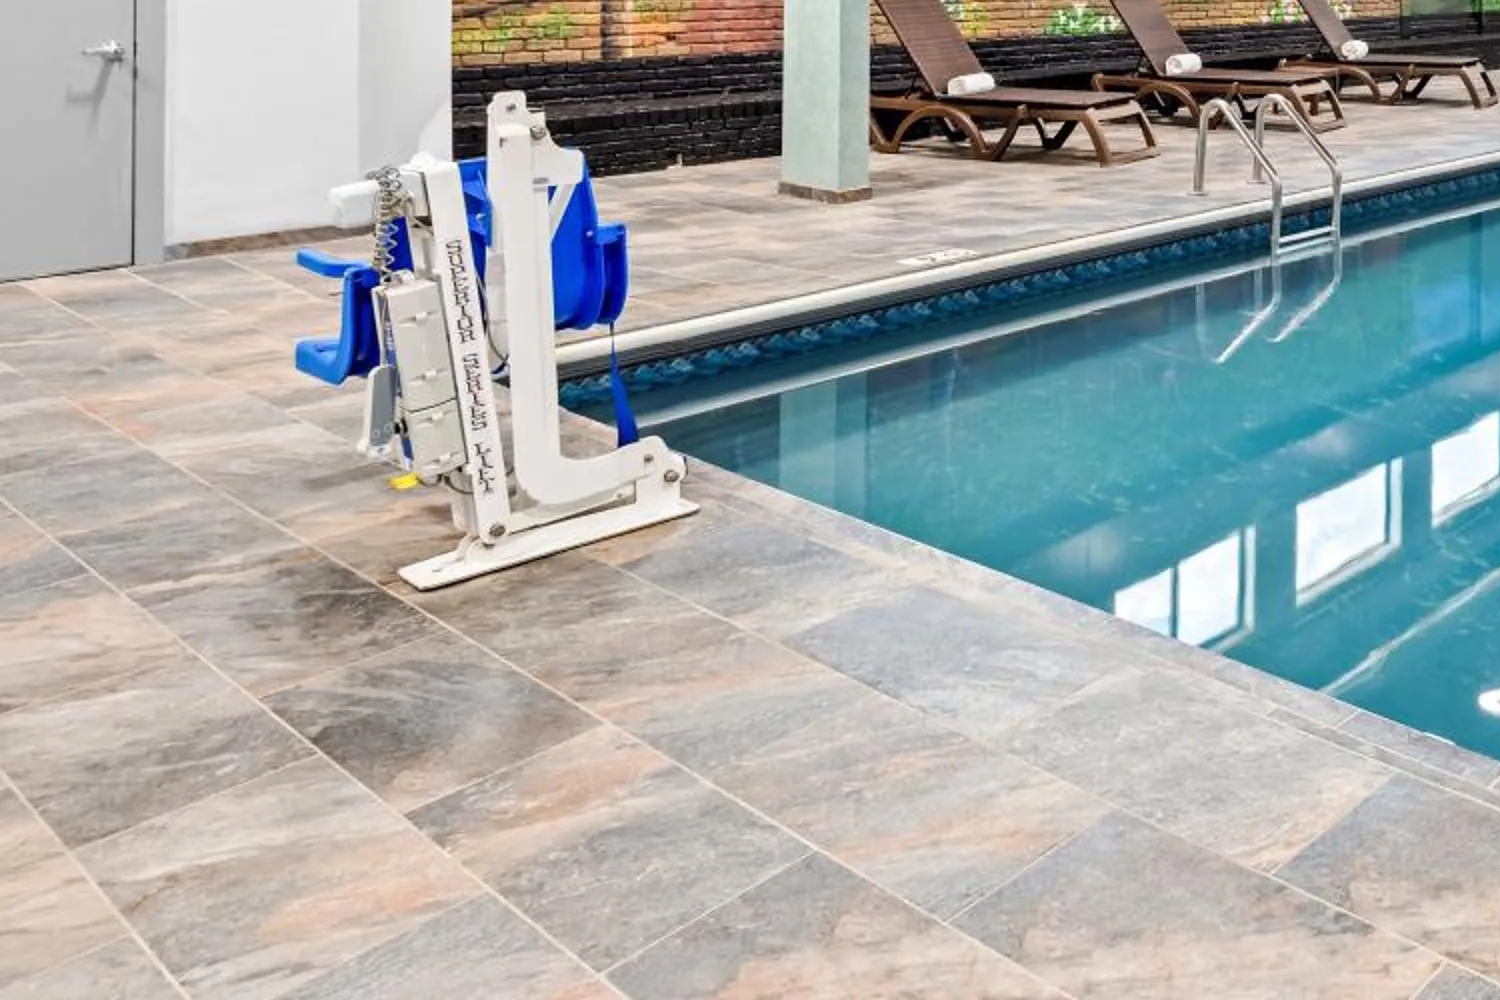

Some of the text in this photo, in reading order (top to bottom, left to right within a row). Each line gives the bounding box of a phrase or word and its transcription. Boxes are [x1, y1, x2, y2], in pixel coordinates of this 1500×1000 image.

[446, 240, 495, 492] SUPERIOR SERIES LIFT
